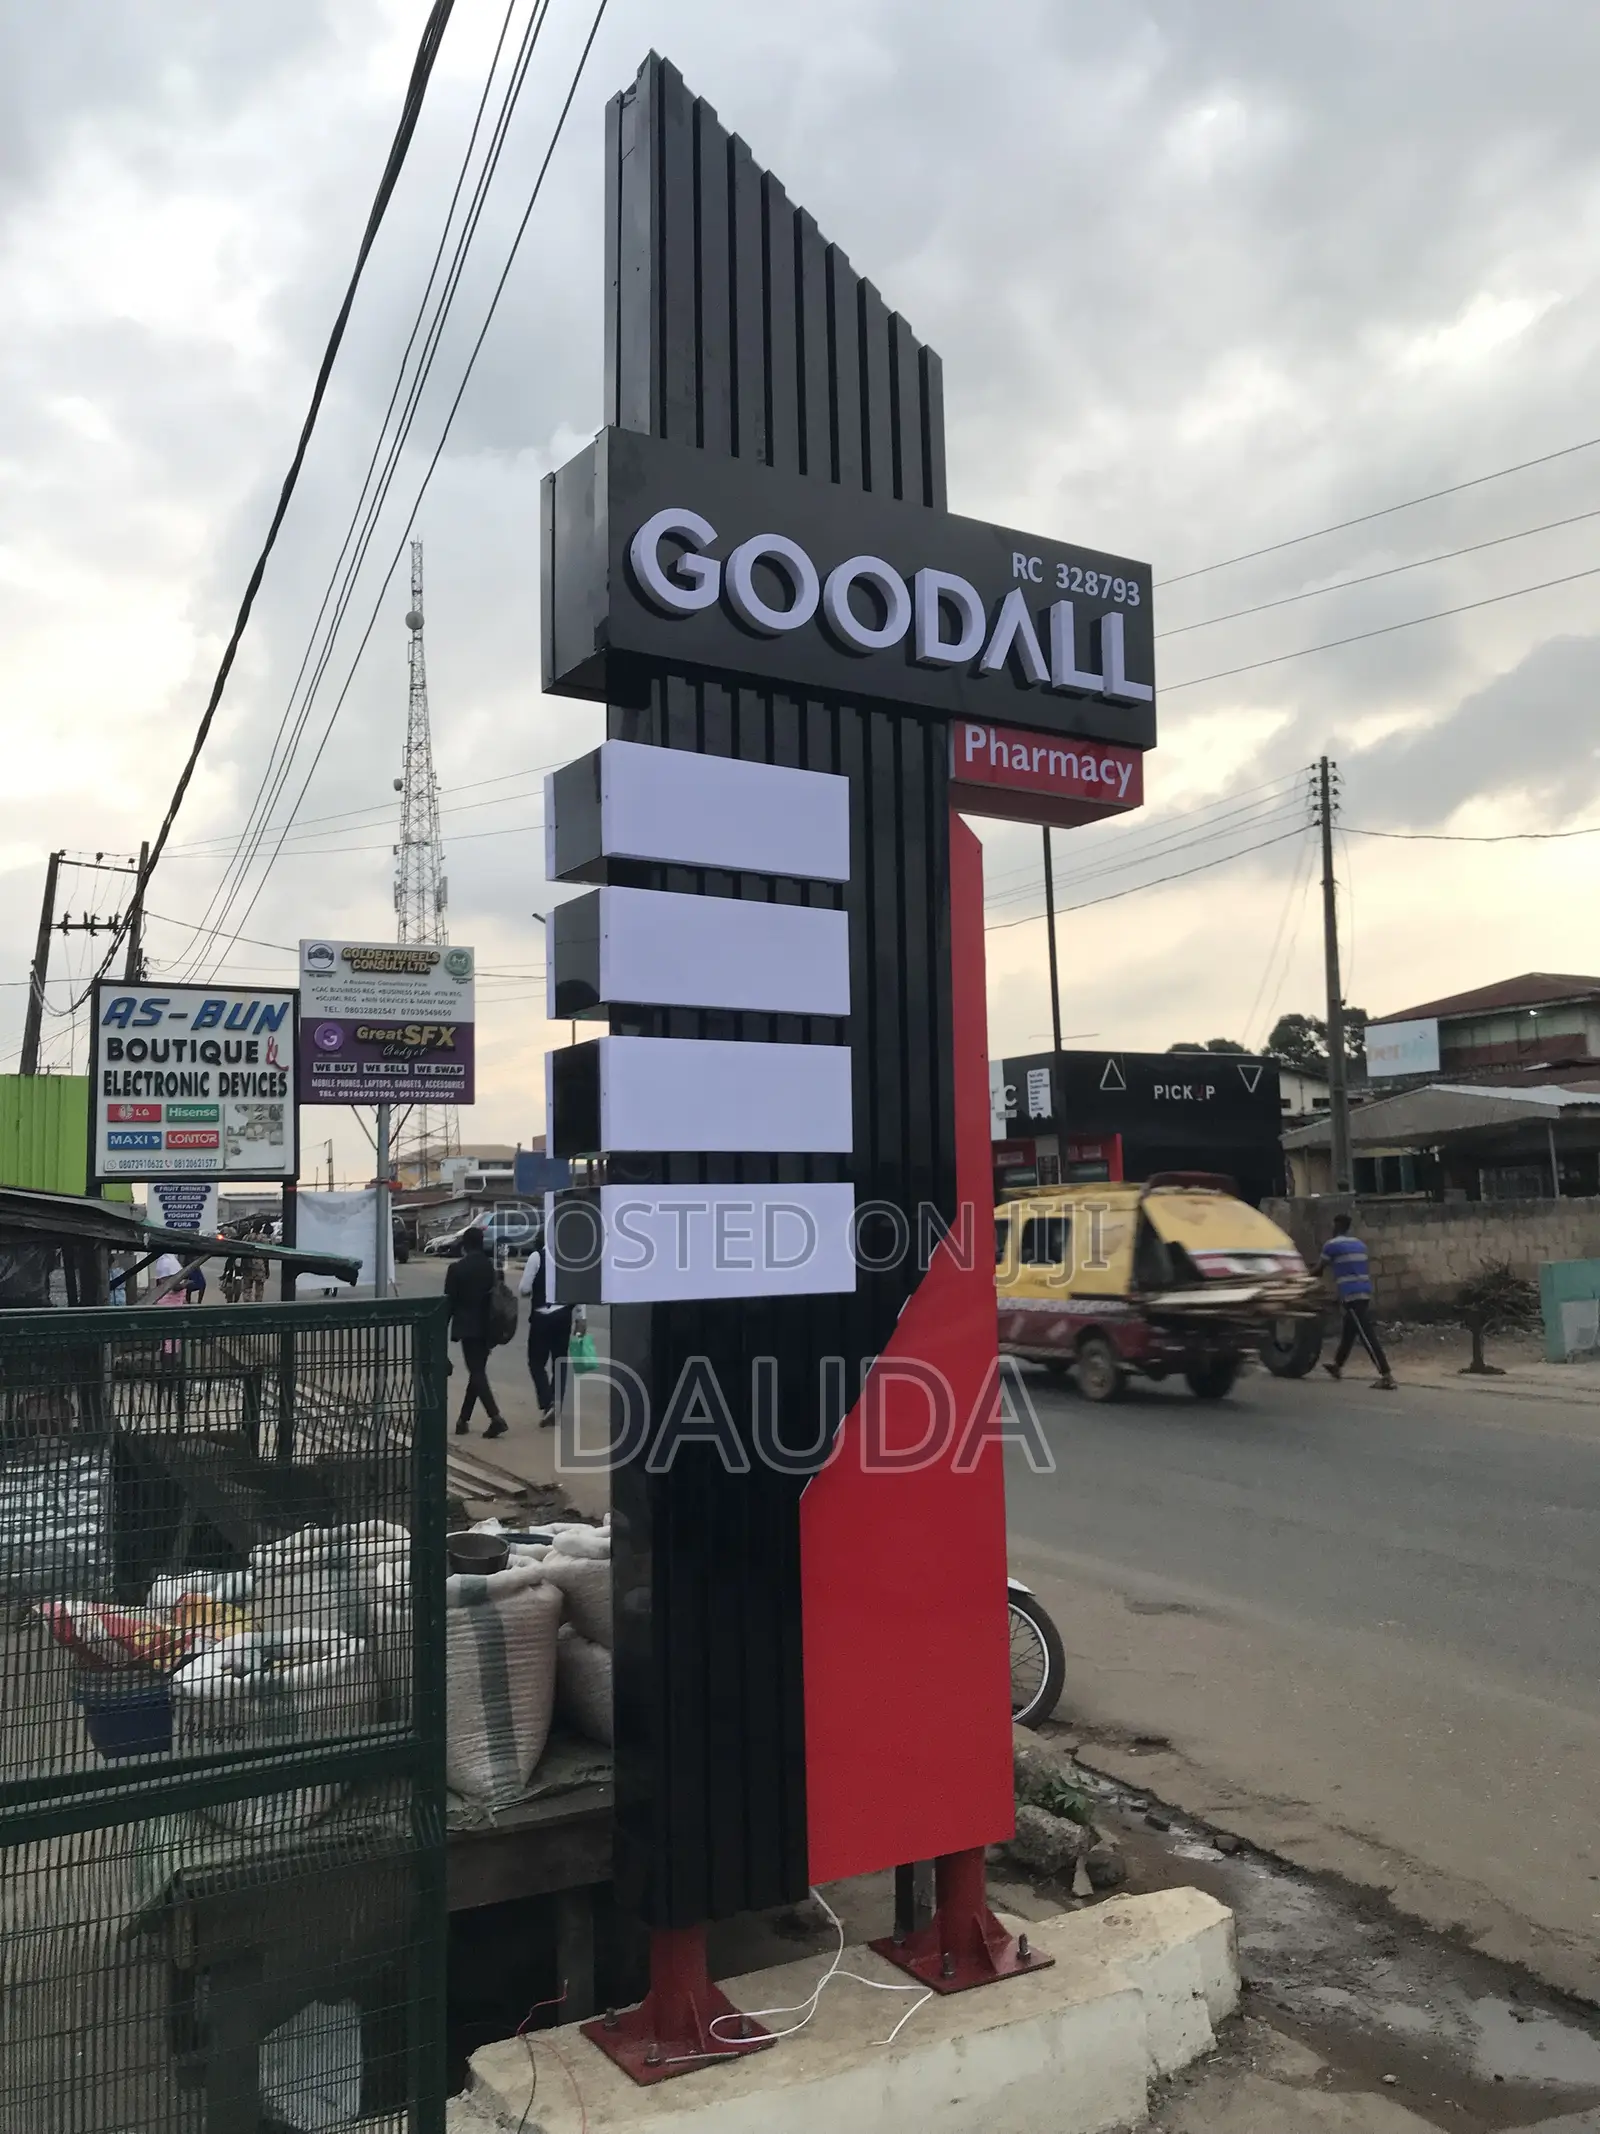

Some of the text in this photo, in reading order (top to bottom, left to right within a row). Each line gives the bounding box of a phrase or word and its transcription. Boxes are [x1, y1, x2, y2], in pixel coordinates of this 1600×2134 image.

[1012, 552, 1140, 606] RC 328793
[630, 508, 1153, 702] GOODALL
[965, 724, 1133, 798] Pharmacy
[342, 947, 440, 964] GOLDEN-WHEELS
[352, 959, 406, 972] CONSULT
[107, 1036, 289, 1071] BOUTIQUE &
[383, 1044, 428, 1060] Gadget
[315, 1063, 355, 1072] WE BUY
[366, 1064, 407, 1073] WE SELL
[417, 1065, 463, 1074] WE SWAP
[104, 1070, 288, 1097] ELECTRONIC DEVICES
[312, 1079, 465, 1089] MOBILE PHONES, LAPTOPS, GADGETS, ACCESSORIES
[136, 1108, 149, 1116] LG
[169, 1107, 218, 1117] Hisense
[110, 1135, 148, 1145] MAXI
[168, 1133, 218, 1144] LONTOR
